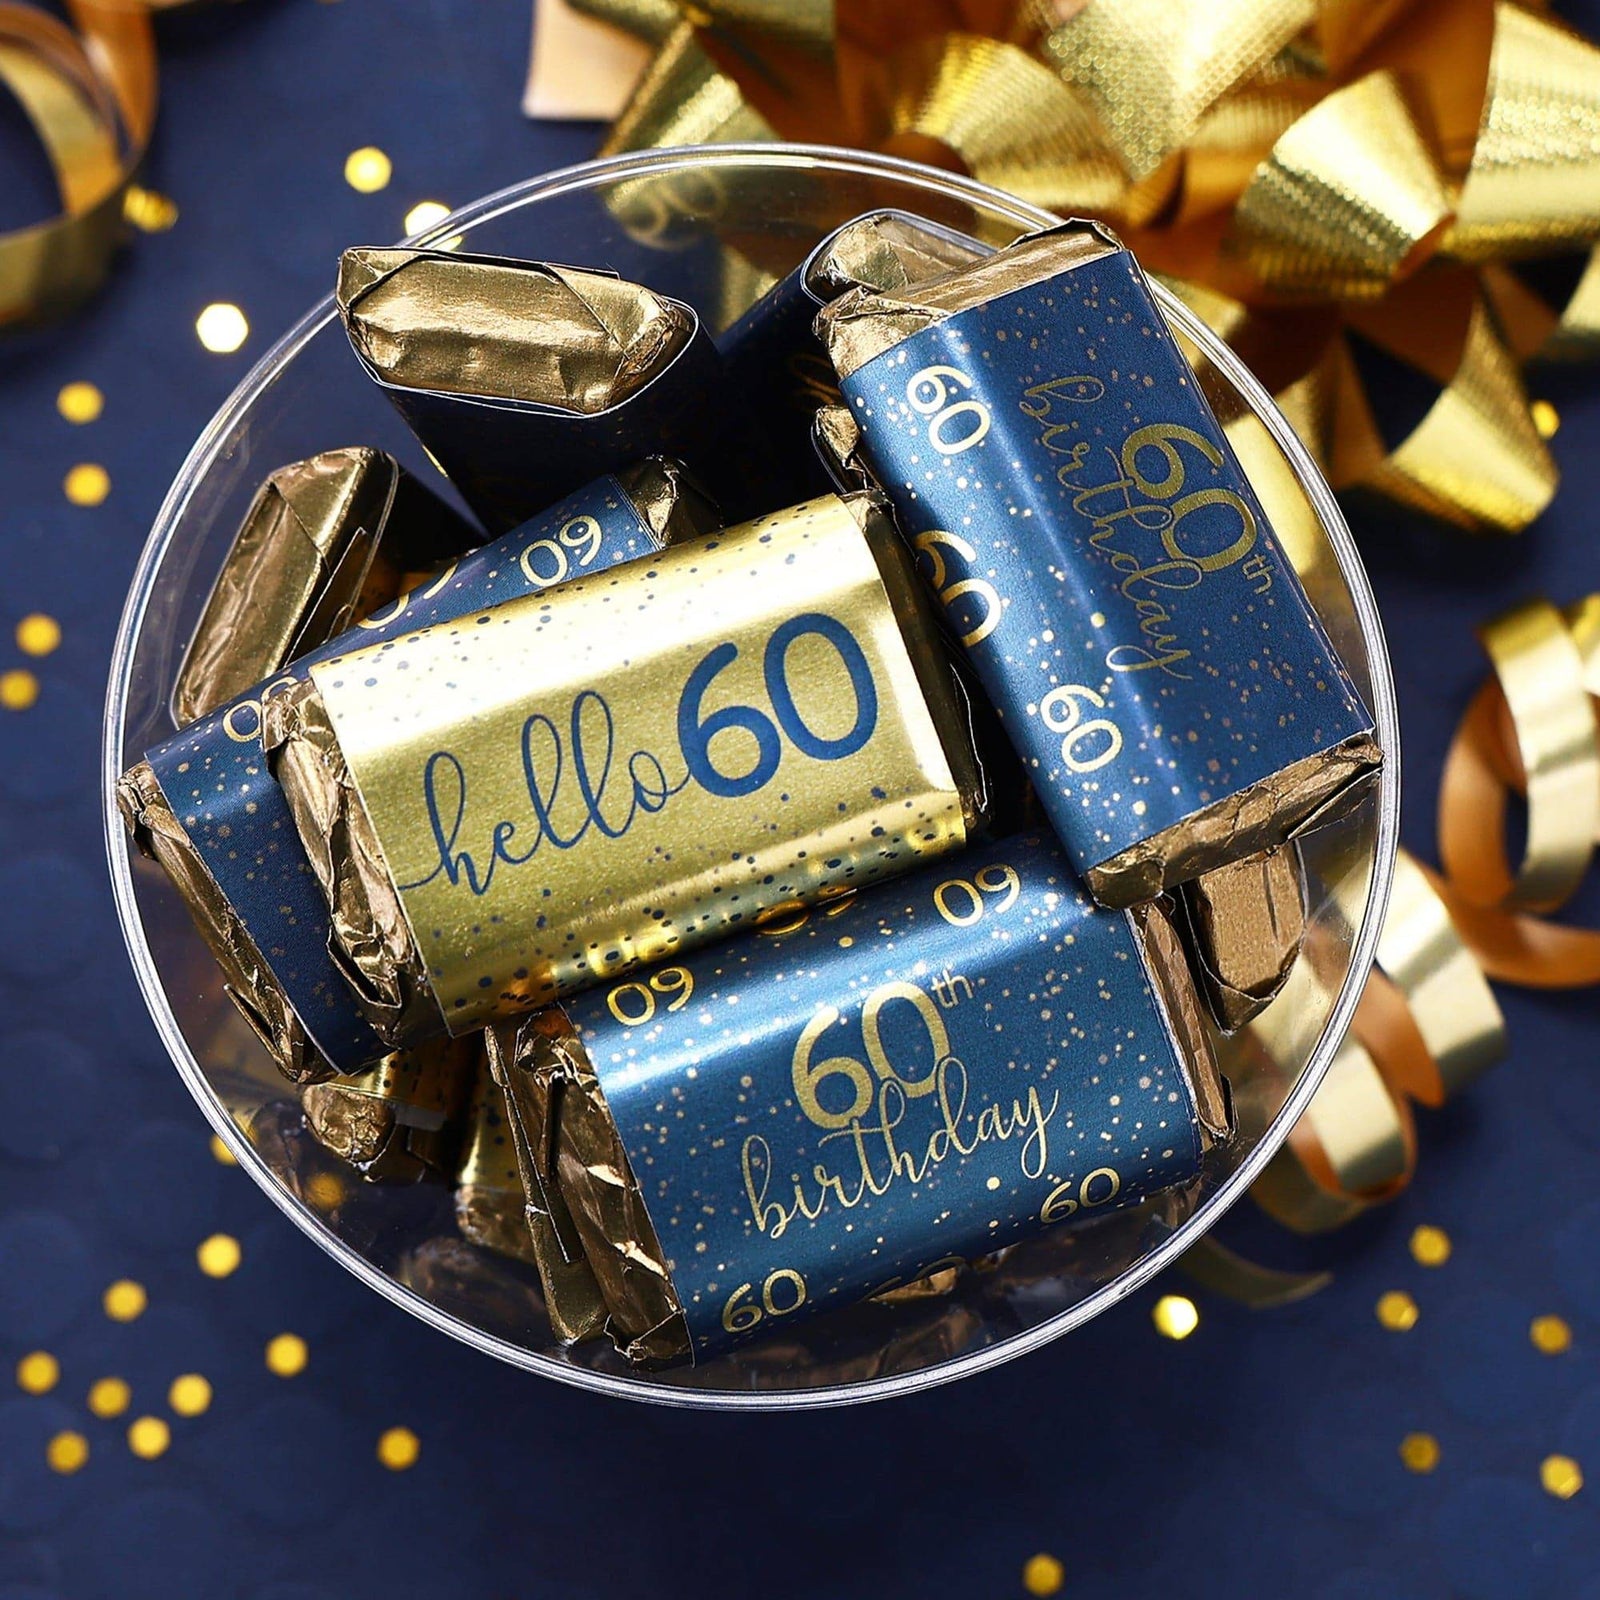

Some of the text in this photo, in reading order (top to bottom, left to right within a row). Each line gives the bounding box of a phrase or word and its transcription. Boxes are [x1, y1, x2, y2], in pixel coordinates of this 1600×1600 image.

[906, 364, 991, 455] 60
[518, 514, 603, 588] 60
[1019, 375, 1204, 681] birthday
[1039, 682, 1124, 773] 60
[933, 863, 1021, 929] 60
[606, 965, 694, 1027] 60
[739, 1055, 1060, 1240] birthday
[1038, 1166, 1121, 1224] 60
[721, 1267, 808, 1334] 60
